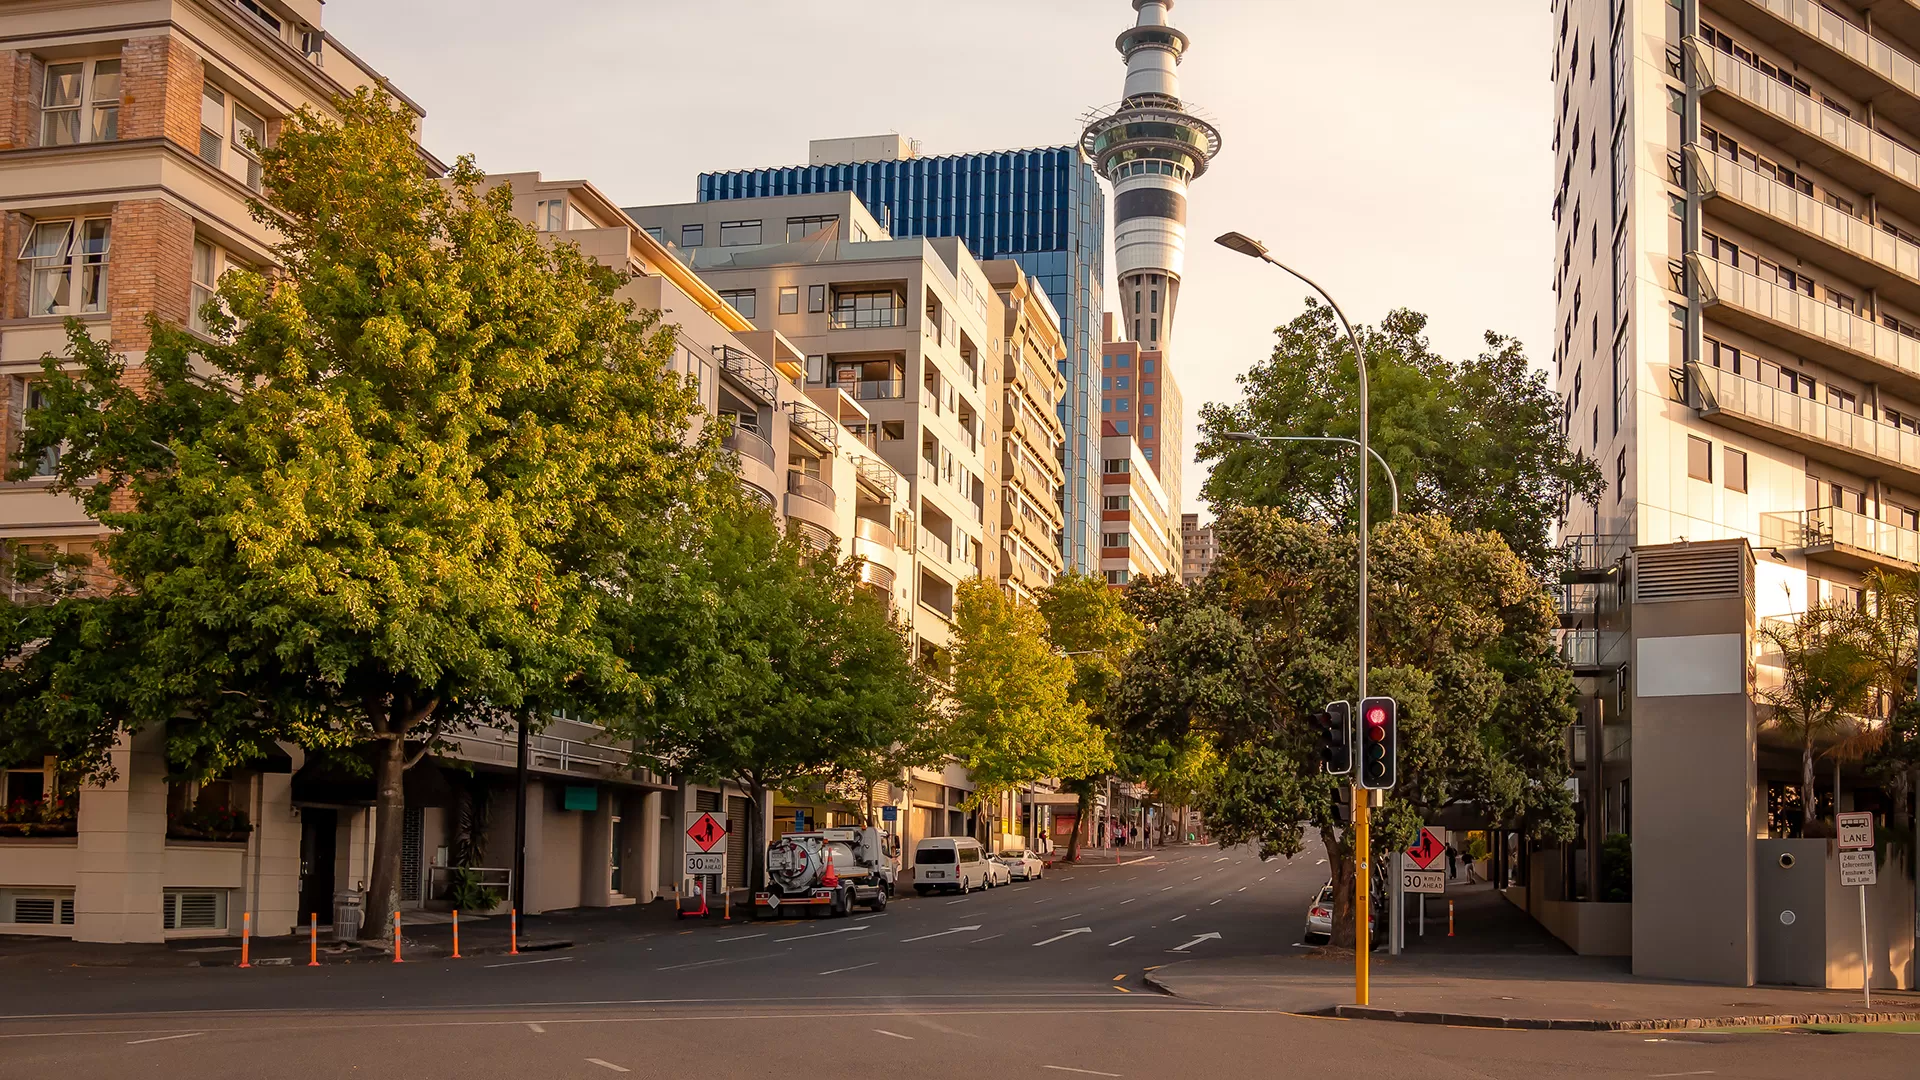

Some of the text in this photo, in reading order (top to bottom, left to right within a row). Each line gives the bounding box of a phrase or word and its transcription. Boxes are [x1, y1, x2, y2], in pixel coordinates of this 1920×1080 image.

[1843, 834, 1868, 842] LANE
[689, 858, 704, 870] 30
[1404, 875, 1421, 888] 30
